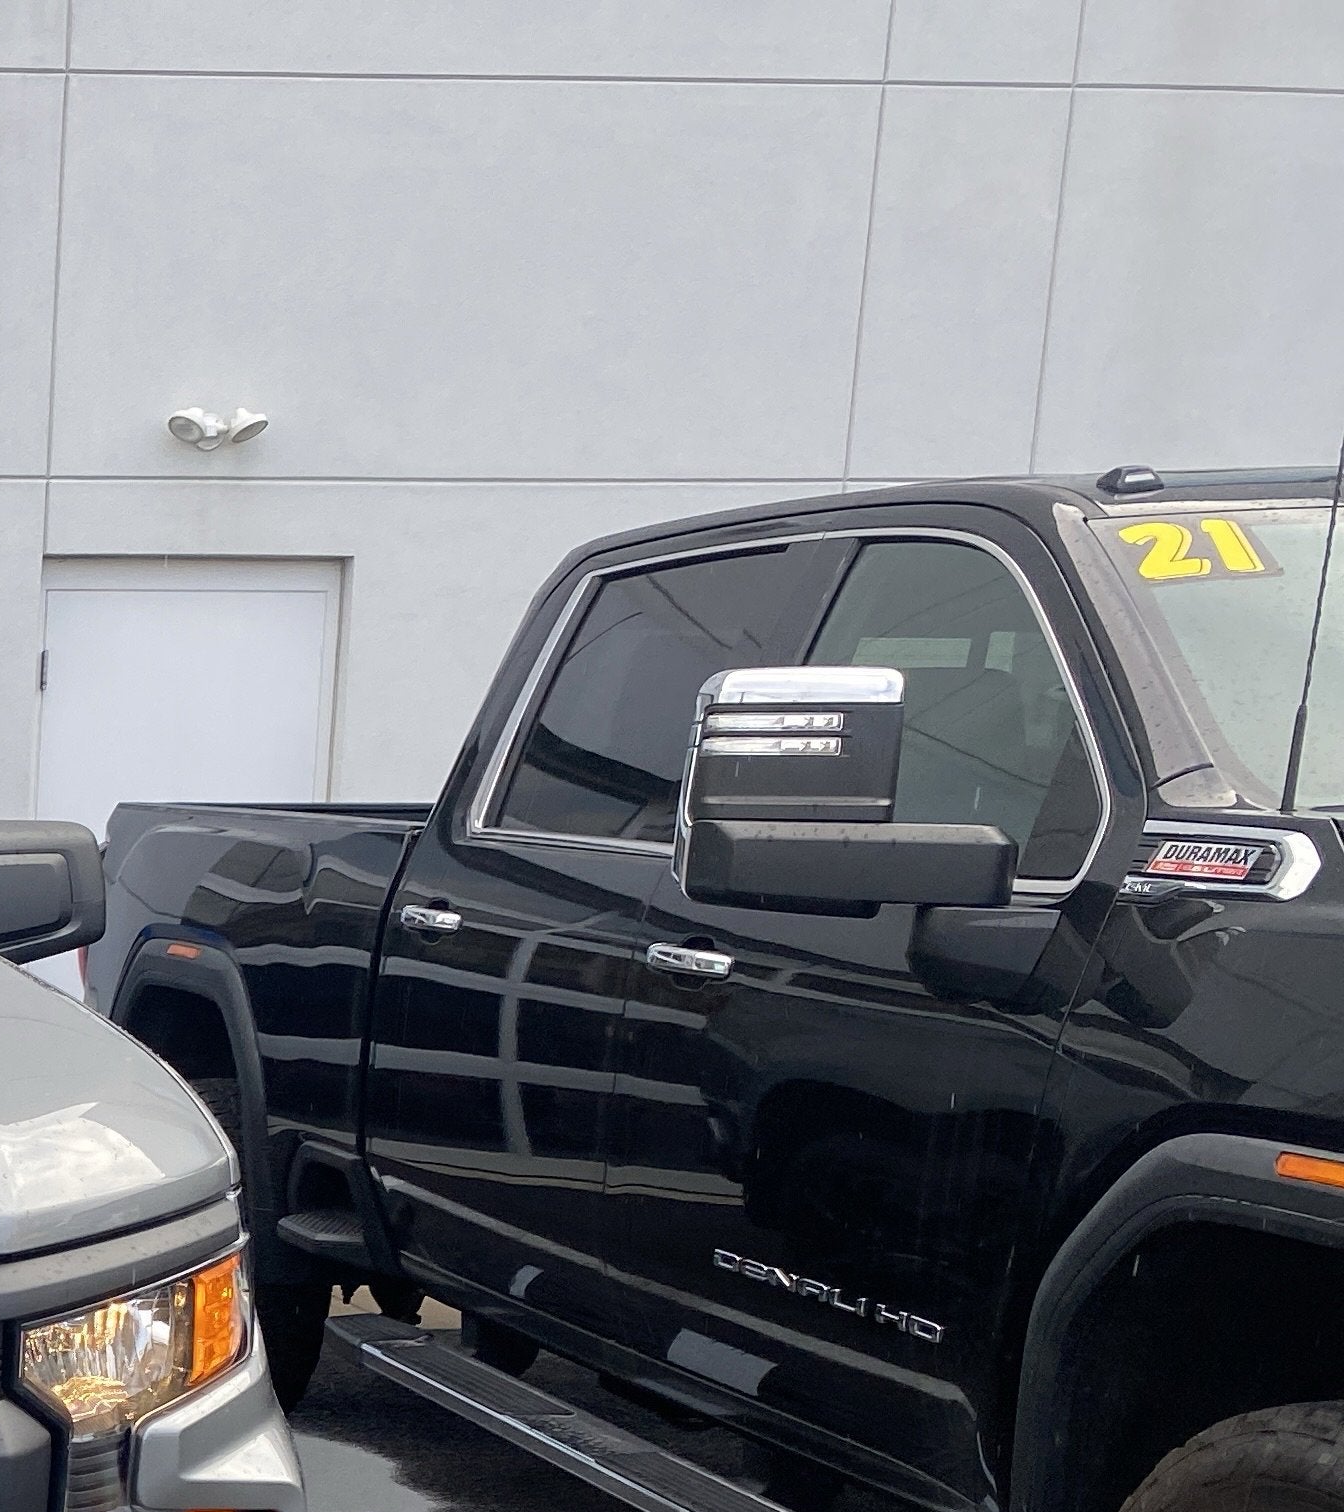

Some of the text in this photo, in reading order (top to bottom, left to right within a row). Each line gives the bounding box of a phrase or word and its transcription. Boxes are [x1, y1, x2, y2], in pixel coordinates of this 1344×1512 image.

[1118, 518, 1265, 579] 21
[1162, 844, 1257, 866] DURAMAX
[714, 1248, 945, 1343] DENALI HD
